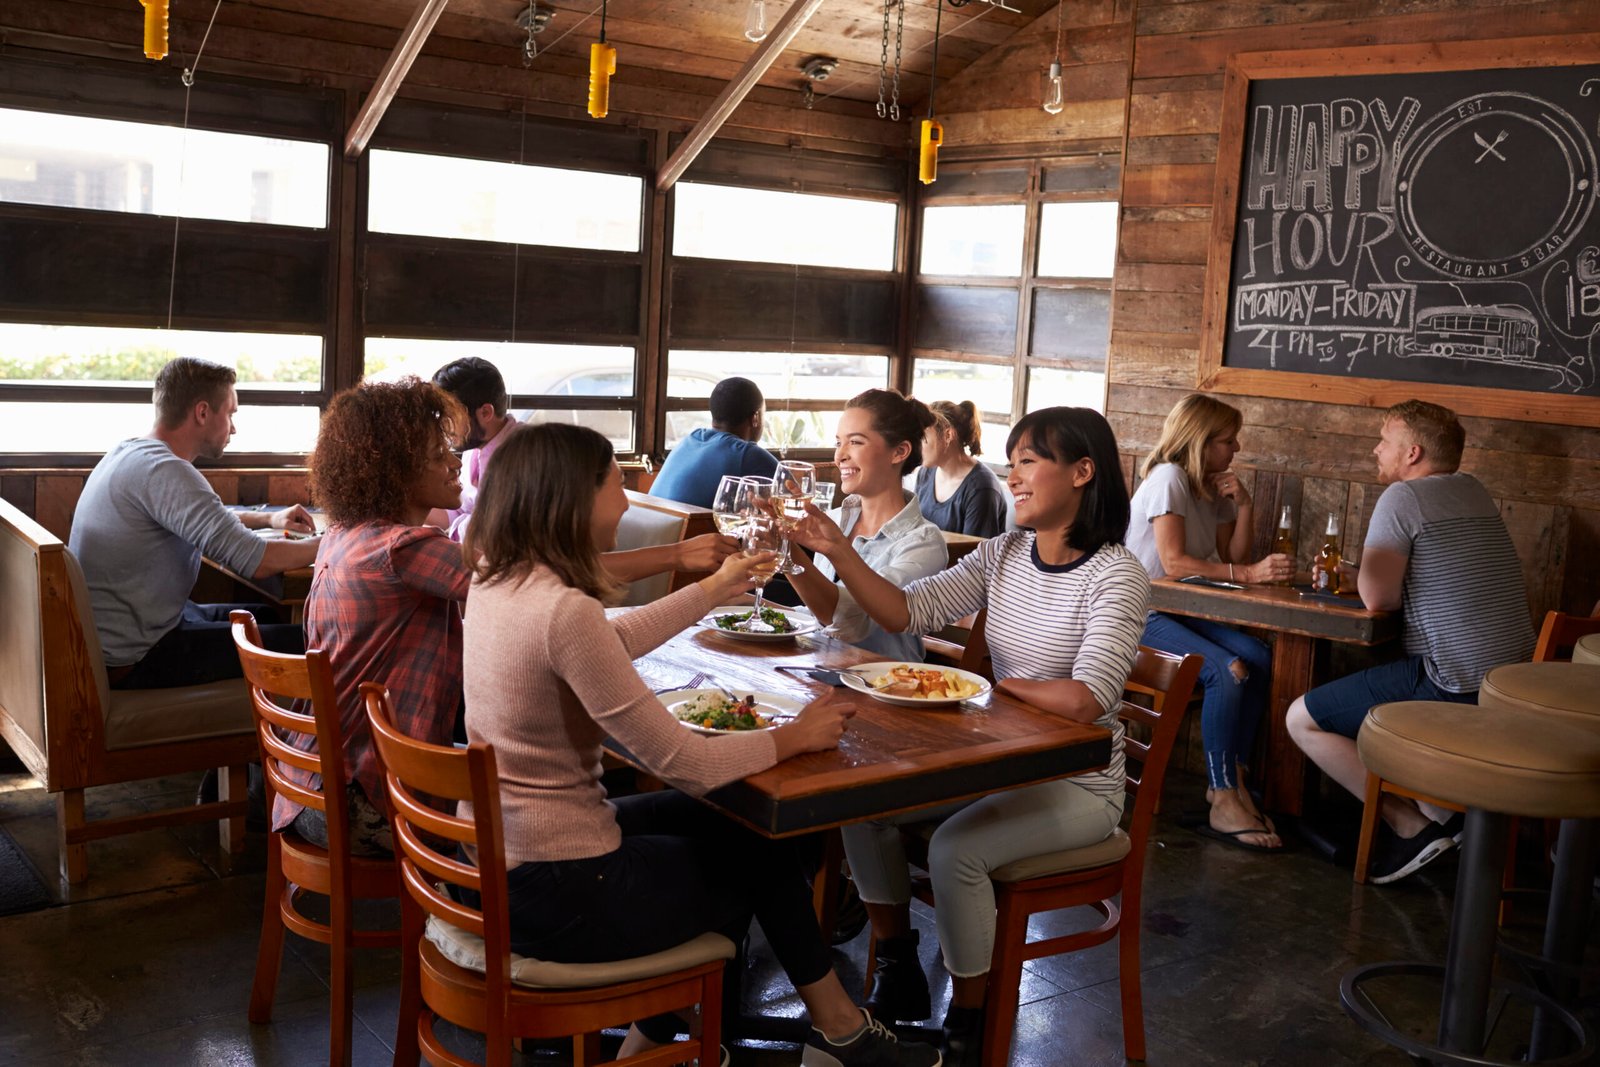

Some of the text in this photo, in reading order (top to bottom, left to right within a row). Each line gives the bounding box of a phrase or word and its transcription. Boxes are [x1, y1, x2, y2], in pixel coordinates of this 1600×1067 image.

[1457, 99, 1493, 119] EST.
[1247, 96, 1422, 212] HAPPY
[1242, 211, 1396, 290] HOUR
[1411, 236, 1509, 277] RESTAURANT
[1533, 234, 1564, 262] BAR
